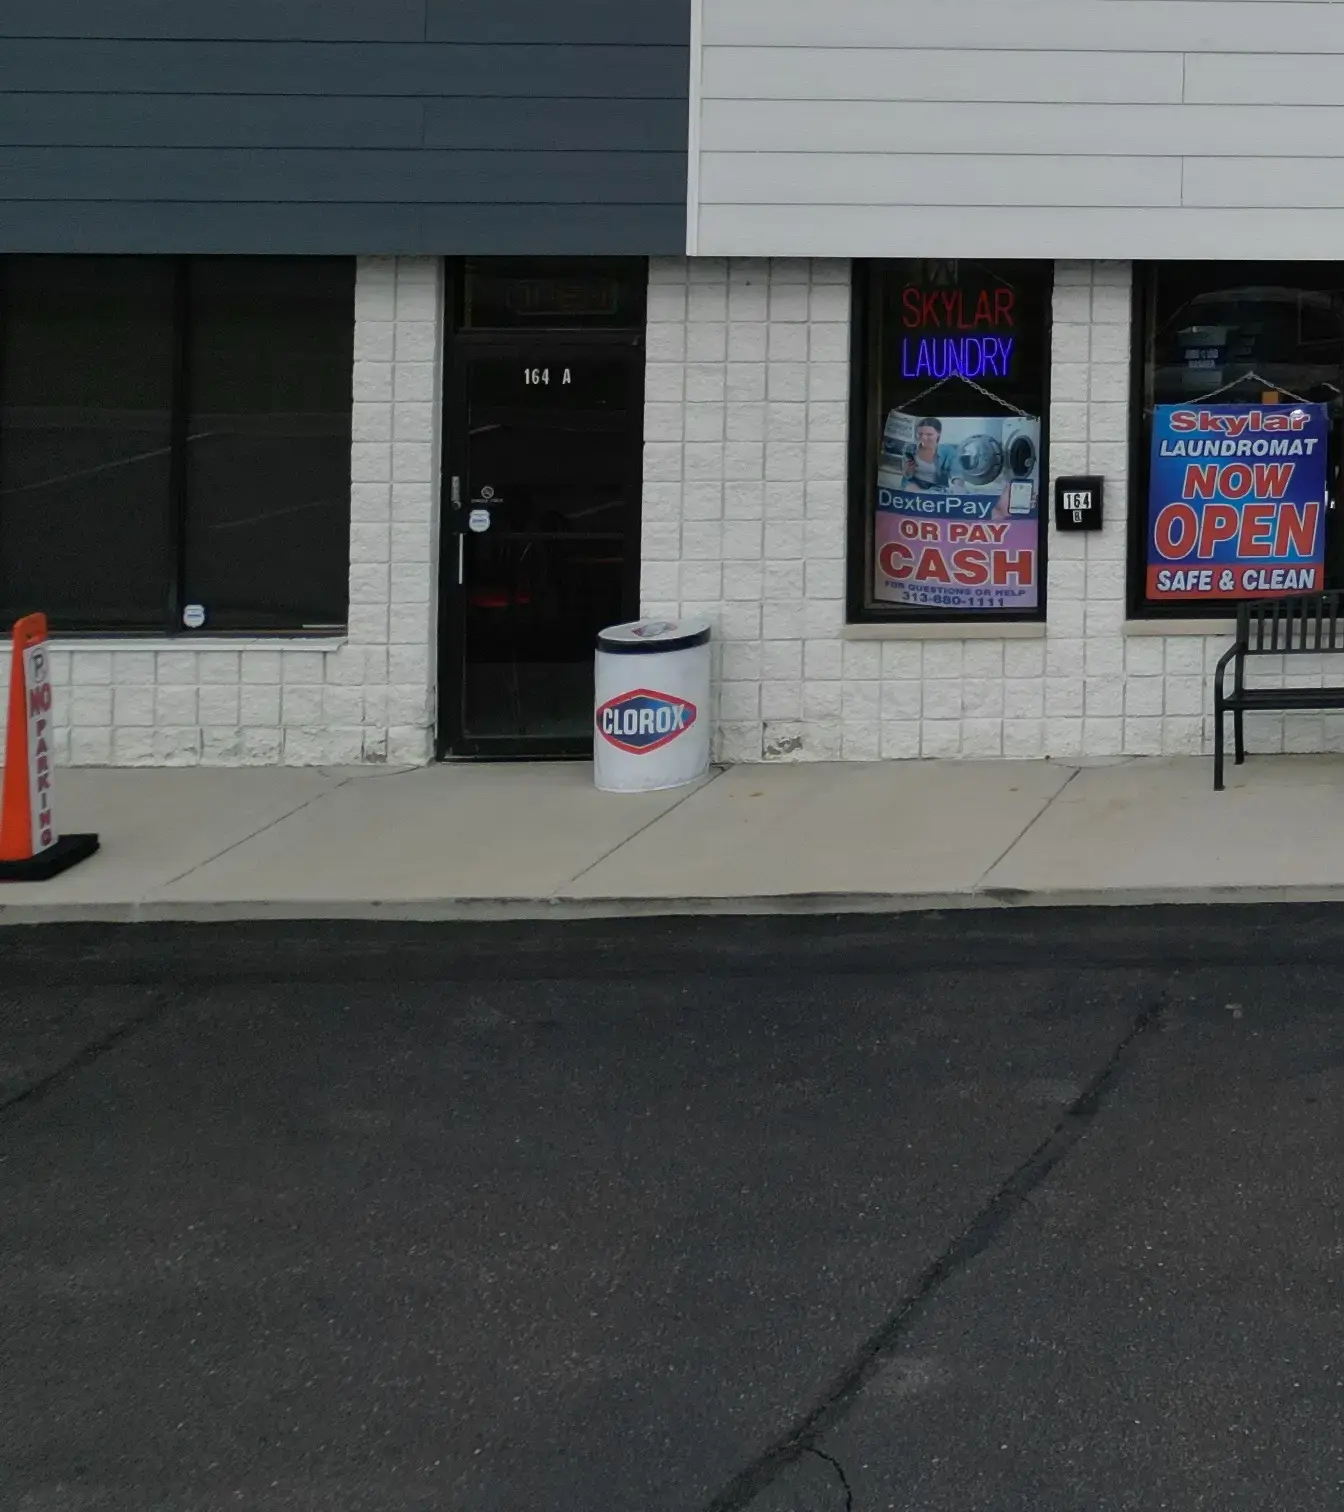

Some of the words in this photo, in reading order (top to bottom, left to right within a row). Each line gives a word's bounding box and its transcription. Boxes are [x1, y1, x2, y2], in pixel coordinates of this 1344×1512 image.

[901, 288, 1015, 328] SKYLAR
[902, 337, 1013, 377] LAUNDRY
[524, 368, 550, 385] 164
[562, 368, 572, 385] A
[1170, 410, 1310, 437] Skylar
[1160, 438, 1318, 457] LAUNDROMAT
[1182, 463, 1295, 500] NOW
[879, 490, 992, 518] DexterPay
[1067, 493, 1090, 509] 164
[901, 520, 941, 542] OR
[950, 522, 1010, 544] PAY
[1154, 502, 1320, 560] OPEN
[879, 542, 1034, 586] CASH
[884, 580, 906, 590] FOR
[908, 583, 971, 596] QUESTIONS
[975, 588, 991, 596] OR
[995, 589, 1026, 597] HELP
[1157, 570, 1213, 592] SAFE
[1219, 570, 1235, 591] &
[1242, 568, 1315, 590] CLEAN
[29, 682, 52, 719] NO
[602, 703, 685, 735] CLOROX
[35, 719, 52, 847] PARKING
